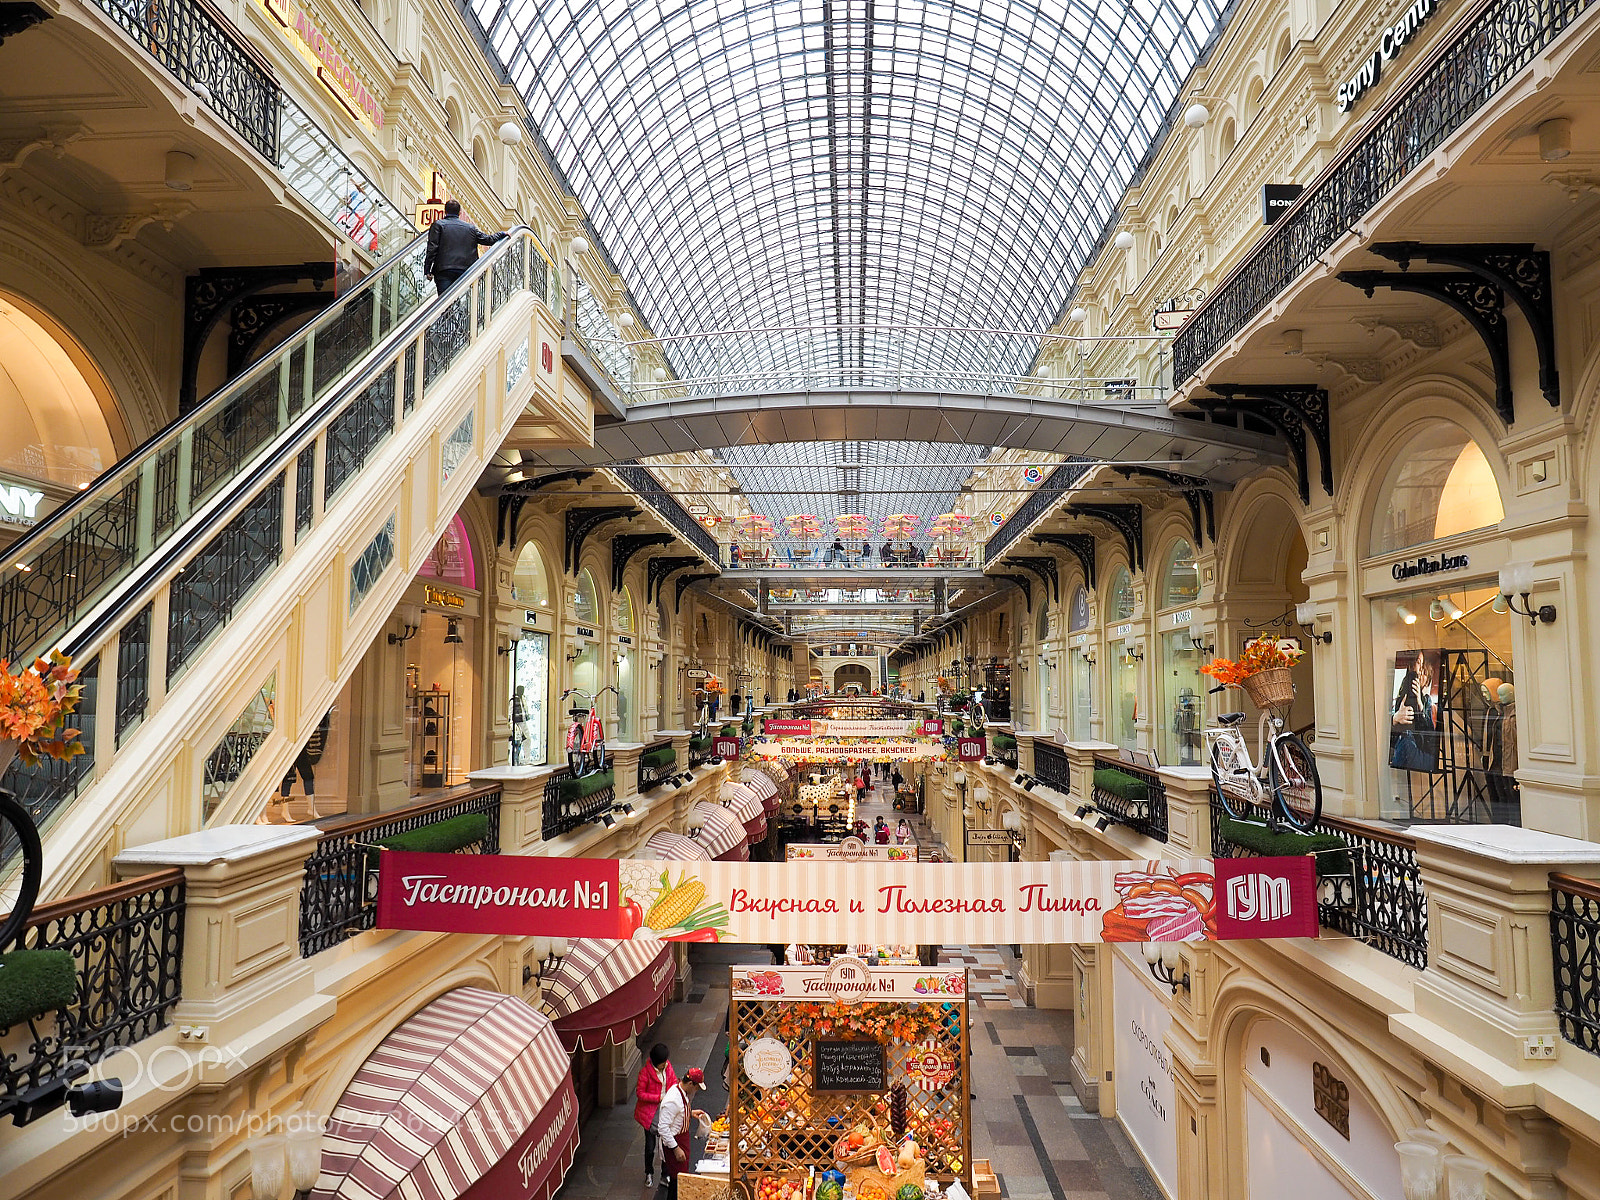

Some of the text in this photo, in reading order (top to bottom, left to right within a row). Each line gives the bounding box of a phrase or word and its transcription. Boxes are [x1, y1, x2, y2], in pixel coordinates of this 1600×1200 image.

[296, 11, 384, 130] АКСЕССУАРЫ
[1337, 0, 1438, 114] Sony Centr
[1391, 553, 1469, 580] Calvin Klein Jeans
[716, 741, 737, 757] ГУМ
[781, 746, 917, 755] БОЛЬШЕ, РАЗНООБРАЗНЕЕ, ВКУСНЕЕ!
[960, 742, 981, 757] ГУМ
[401, 874, 609, 910] Гастроном №1
[729, 883, 1102, 920] Вкусная и Полезная Пища
[1226, 873, 1292, 922] ГУМ
[802, 978, 895, 994] Гастроном №1
[840, 967, 856, 980] ГУМ
[517, 1107, 566, 1190] Гастроном
